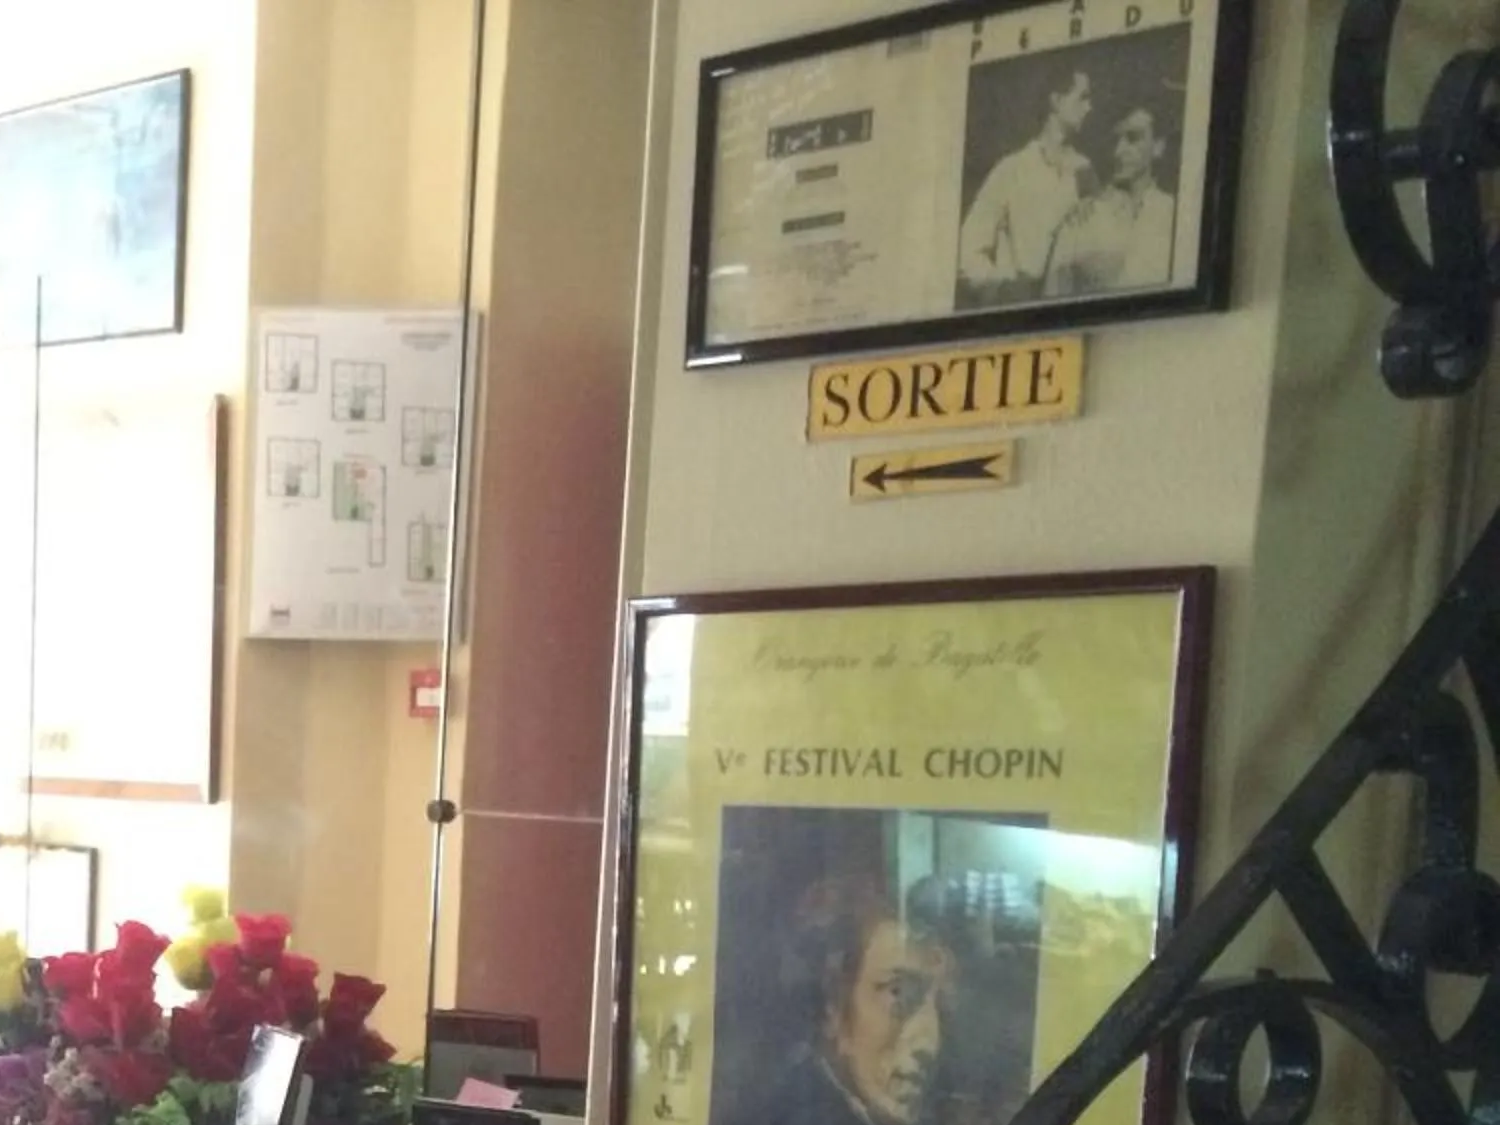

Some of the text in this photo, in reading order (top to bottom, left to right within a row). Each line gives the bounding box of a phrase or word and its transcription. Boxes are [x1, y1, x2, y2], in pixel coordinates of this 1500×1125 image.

[822, 346, 1064, 428] SORTIE
[763, 747, 904, 778] FESTIVAL
[923, 747, 1064, 780] CHOPIN
